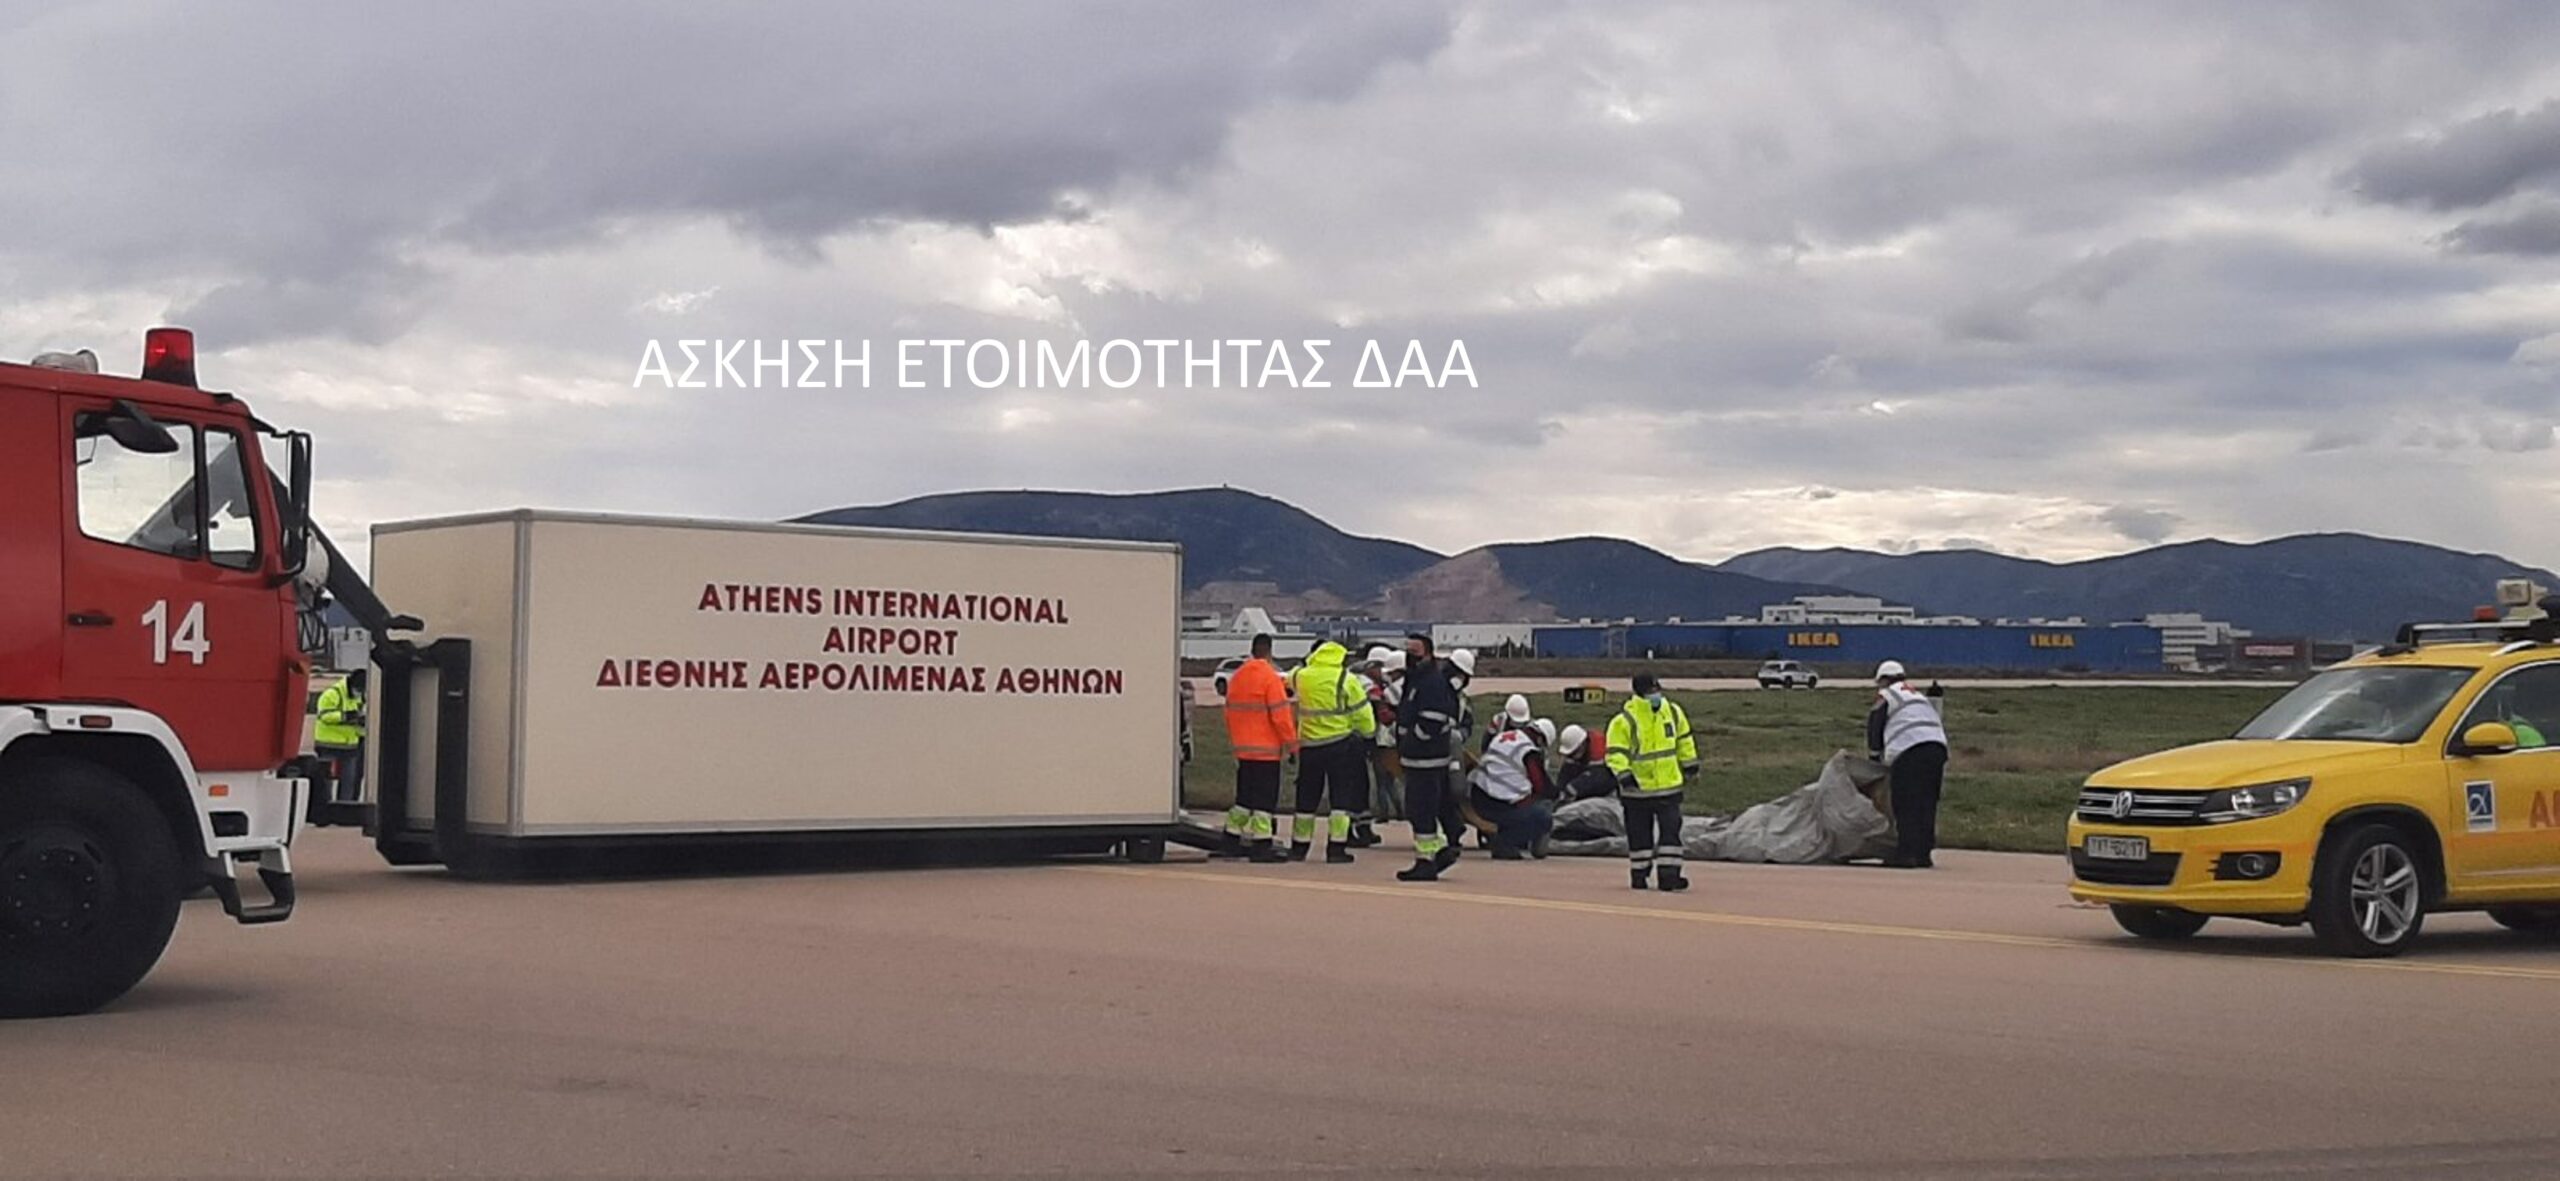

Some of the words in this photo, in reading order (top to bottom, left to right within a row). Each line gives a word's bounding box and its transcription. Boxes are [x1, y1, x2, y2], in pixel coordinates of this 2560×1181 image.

[697, 583, 823, 615] ATHENS
[833, 590, 1069, 624] INTERNATIONAL
[142, 599, 210, 665] 14
[823, 627, 958, 656] AIRPORT
[1788, 632, 1840, 647] IKEA
[2030, 633, 2075, 648] IKEA
[596, 660, 748, 689] ΔΙΕΘΝΗΣ
[759, 662, 987, 694] ΑΕΡΟΛΙΜΕΝΑΣ
[995, 668, 1124, 695] ΑΘΗΝΩΝ
